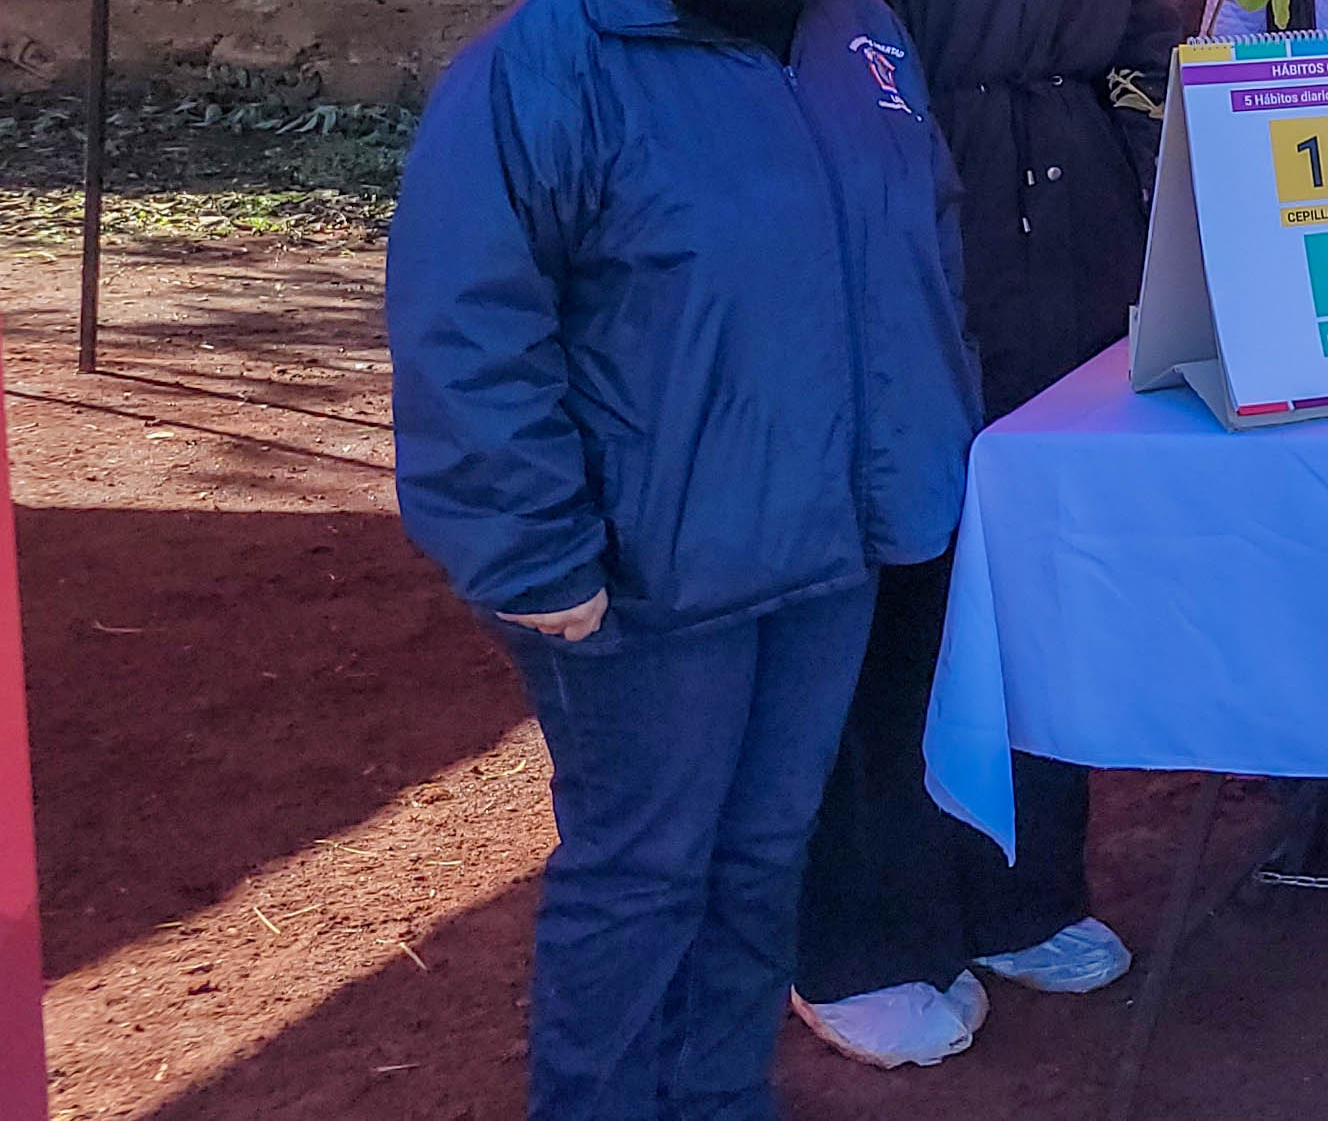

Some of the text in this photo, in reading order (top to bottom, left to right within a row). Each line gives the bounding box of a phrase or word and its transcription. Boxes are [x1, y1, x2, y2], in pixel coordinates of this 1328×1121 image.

[1271, 62, 1324, 77] HÁBITOS
[1244, 95, 1253, 107] 5
[1254, 89, 1298, 105] Hábitos
[1297, 136, 1324, 188] 1
